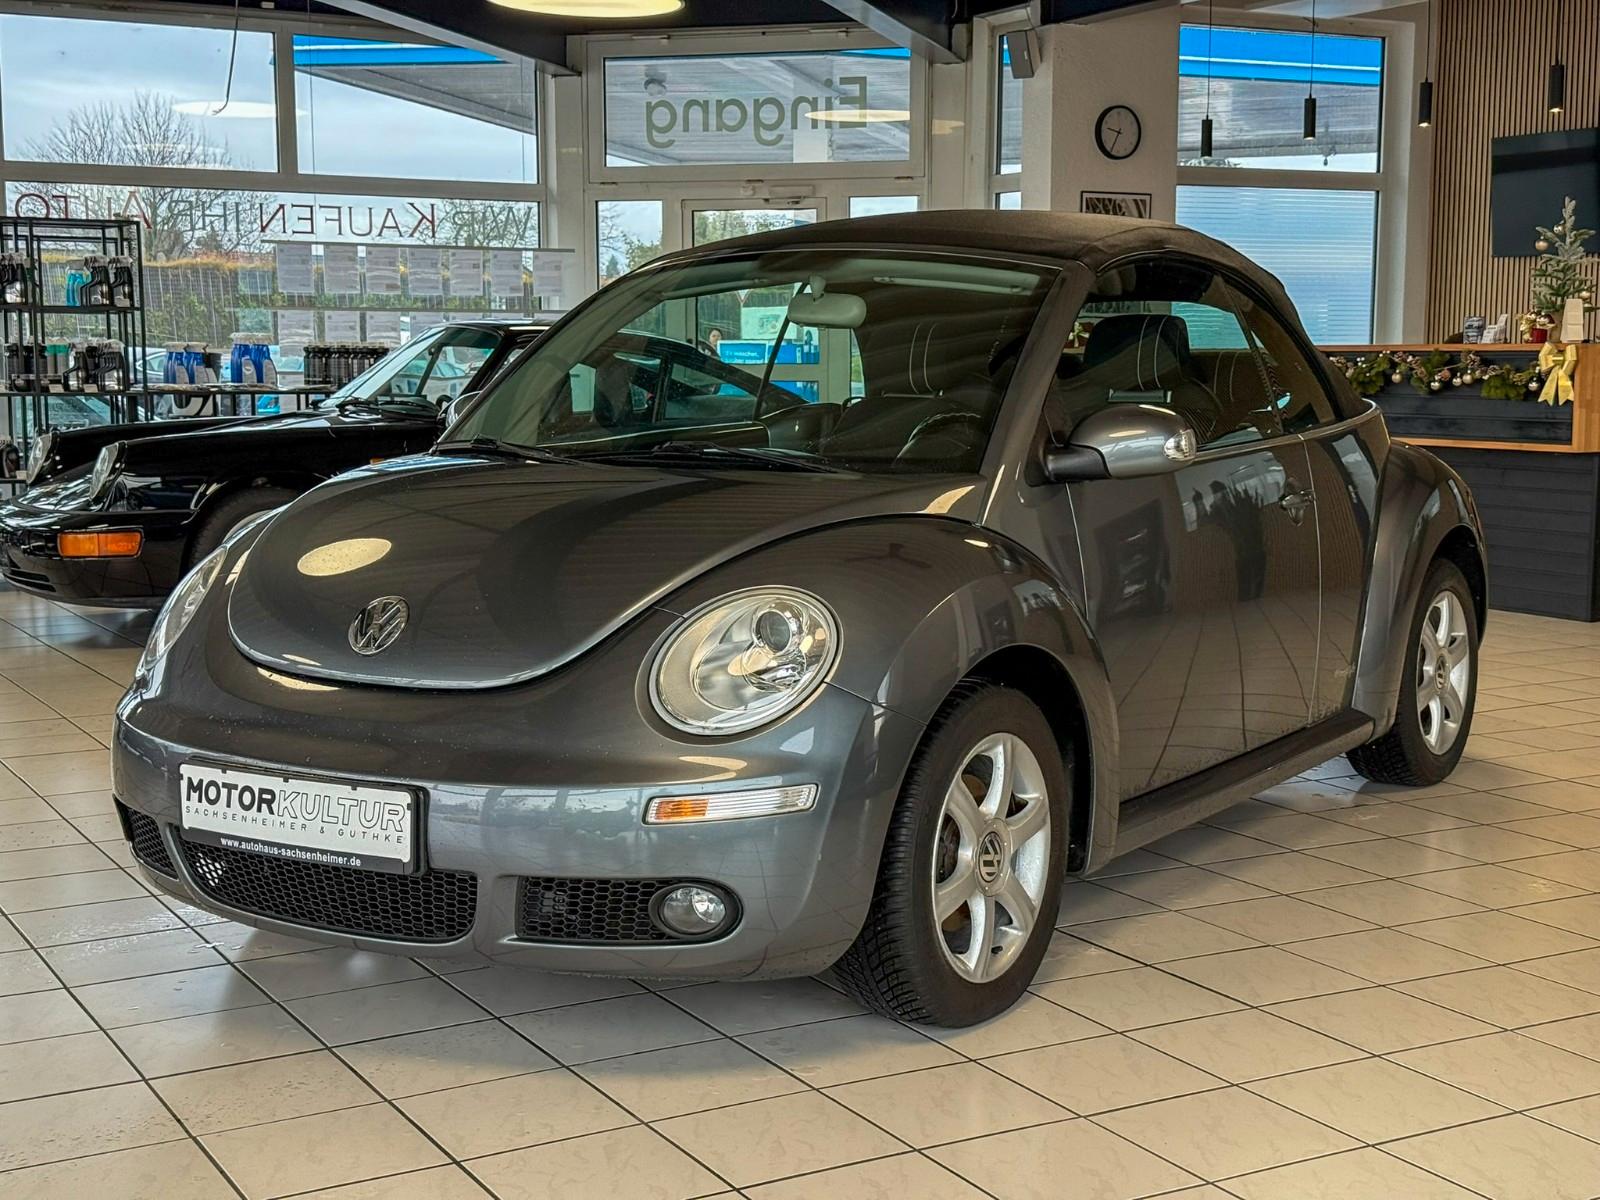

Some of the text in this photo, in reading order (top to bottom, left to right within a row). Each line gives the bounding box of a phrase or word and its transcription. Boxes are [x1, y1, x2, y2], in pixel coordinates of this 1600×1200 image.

[186, 776, 405, 832] MOTORKULTUR
[185, 806, 403, 844] SACHSENHEIMER & GUTHKE
[220, 837, 362, 867] www.autohaus-sachsenheimer.de
